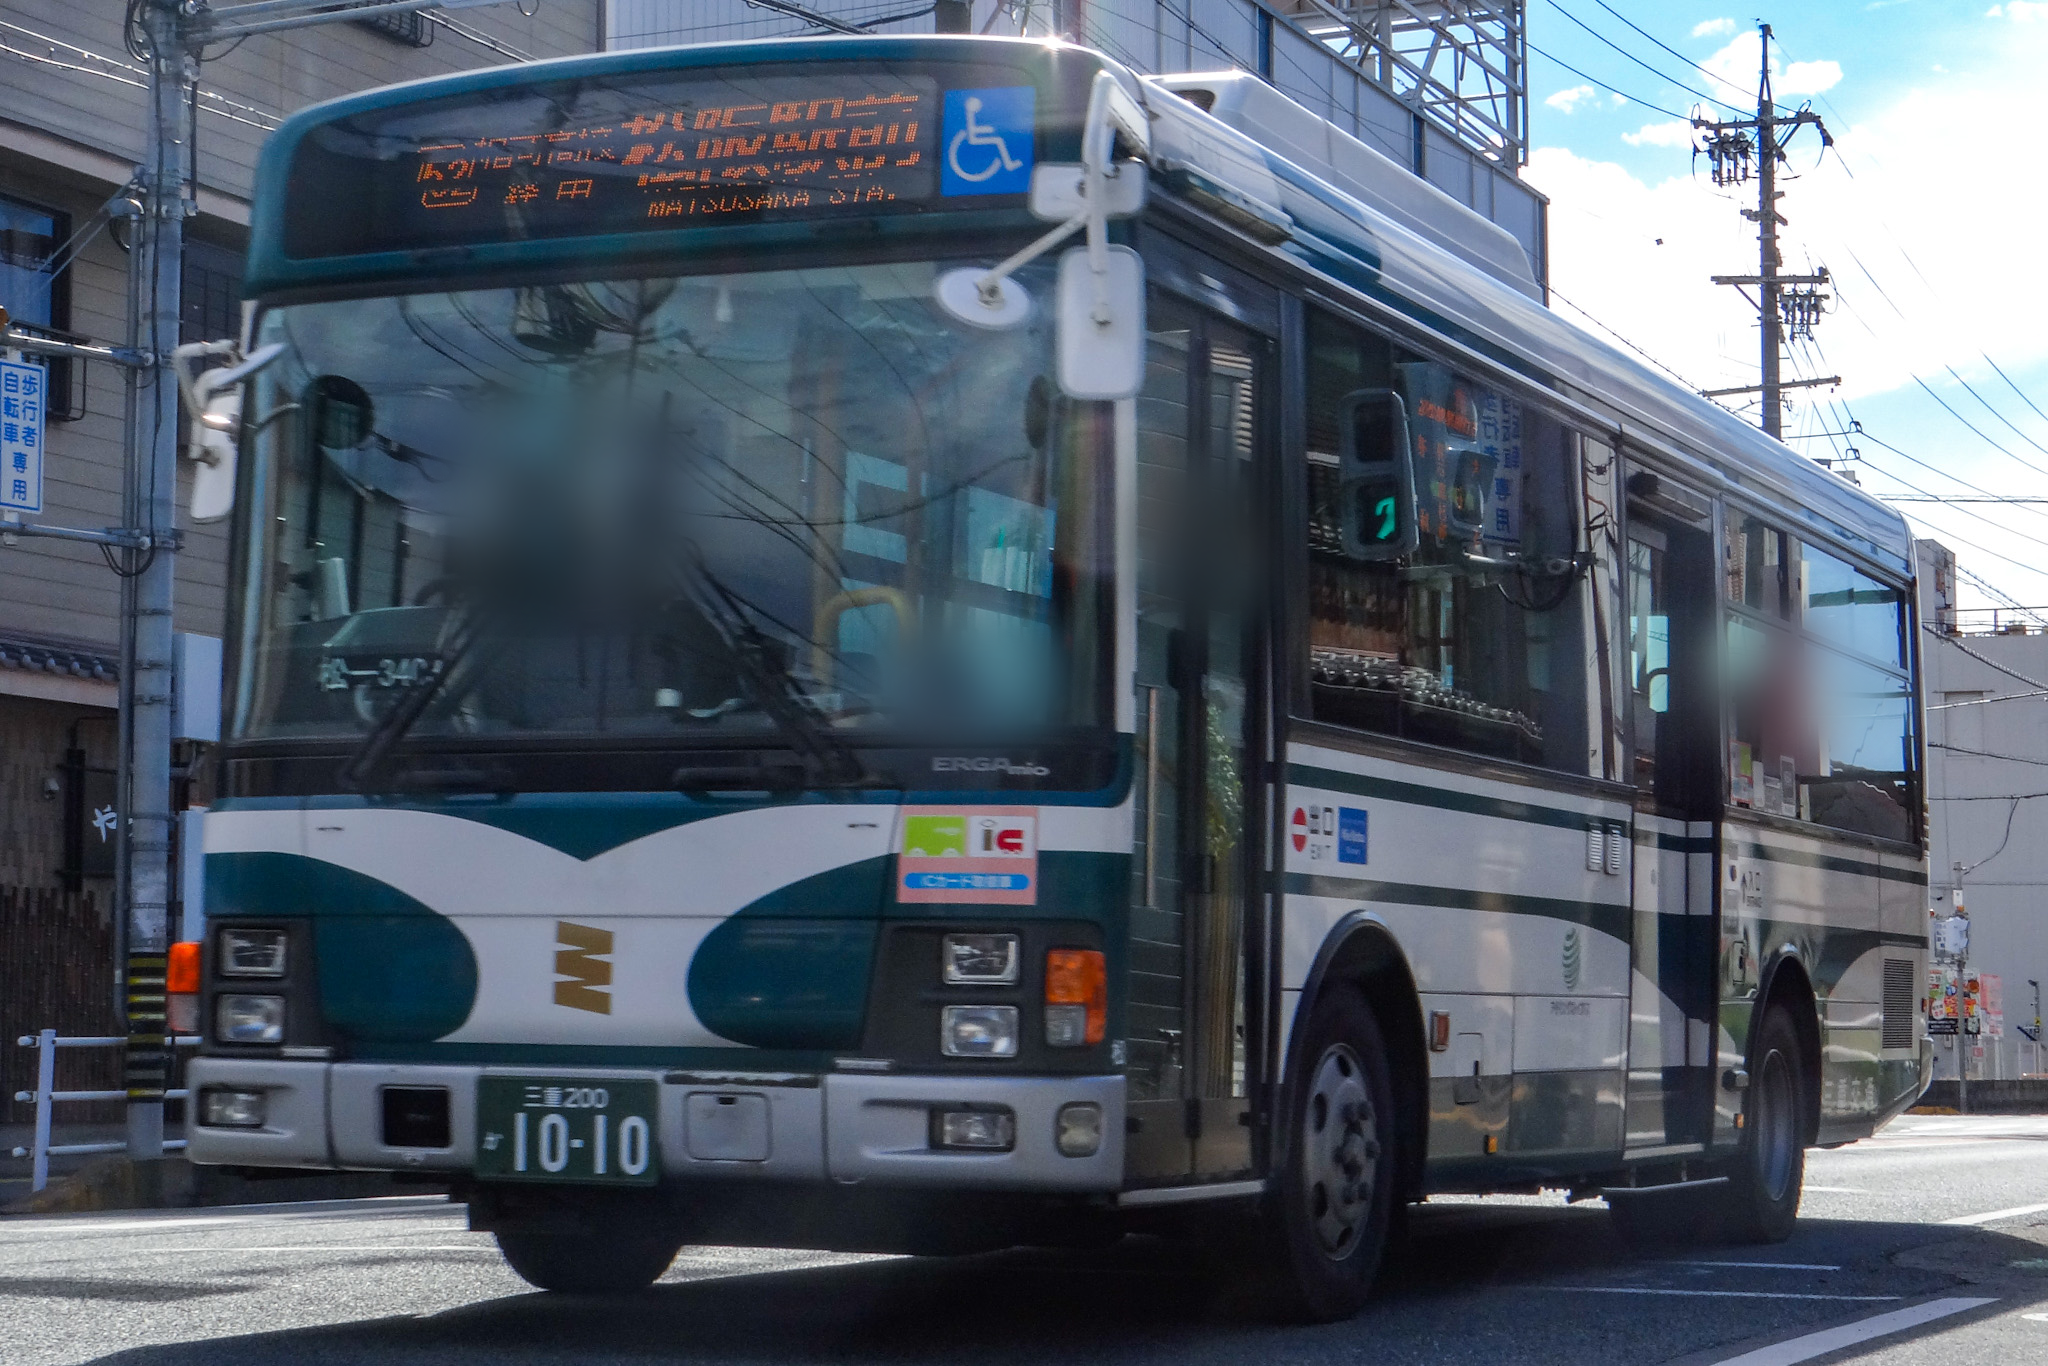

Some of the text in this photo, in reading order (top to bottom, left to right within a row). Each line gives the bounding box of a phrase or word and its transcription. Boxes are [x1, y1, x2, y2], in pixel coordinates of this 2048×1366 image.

[3, 371, 20, 444] 自転車
[21, 374, 39, 448] 歩行者
[12, 451, 28, 501] 専用
[930, 757, 1052, 776] ERGAmio
[1309, 804, 1333, 836] 出口
[513, 1112, 650, 1175] 10-10
